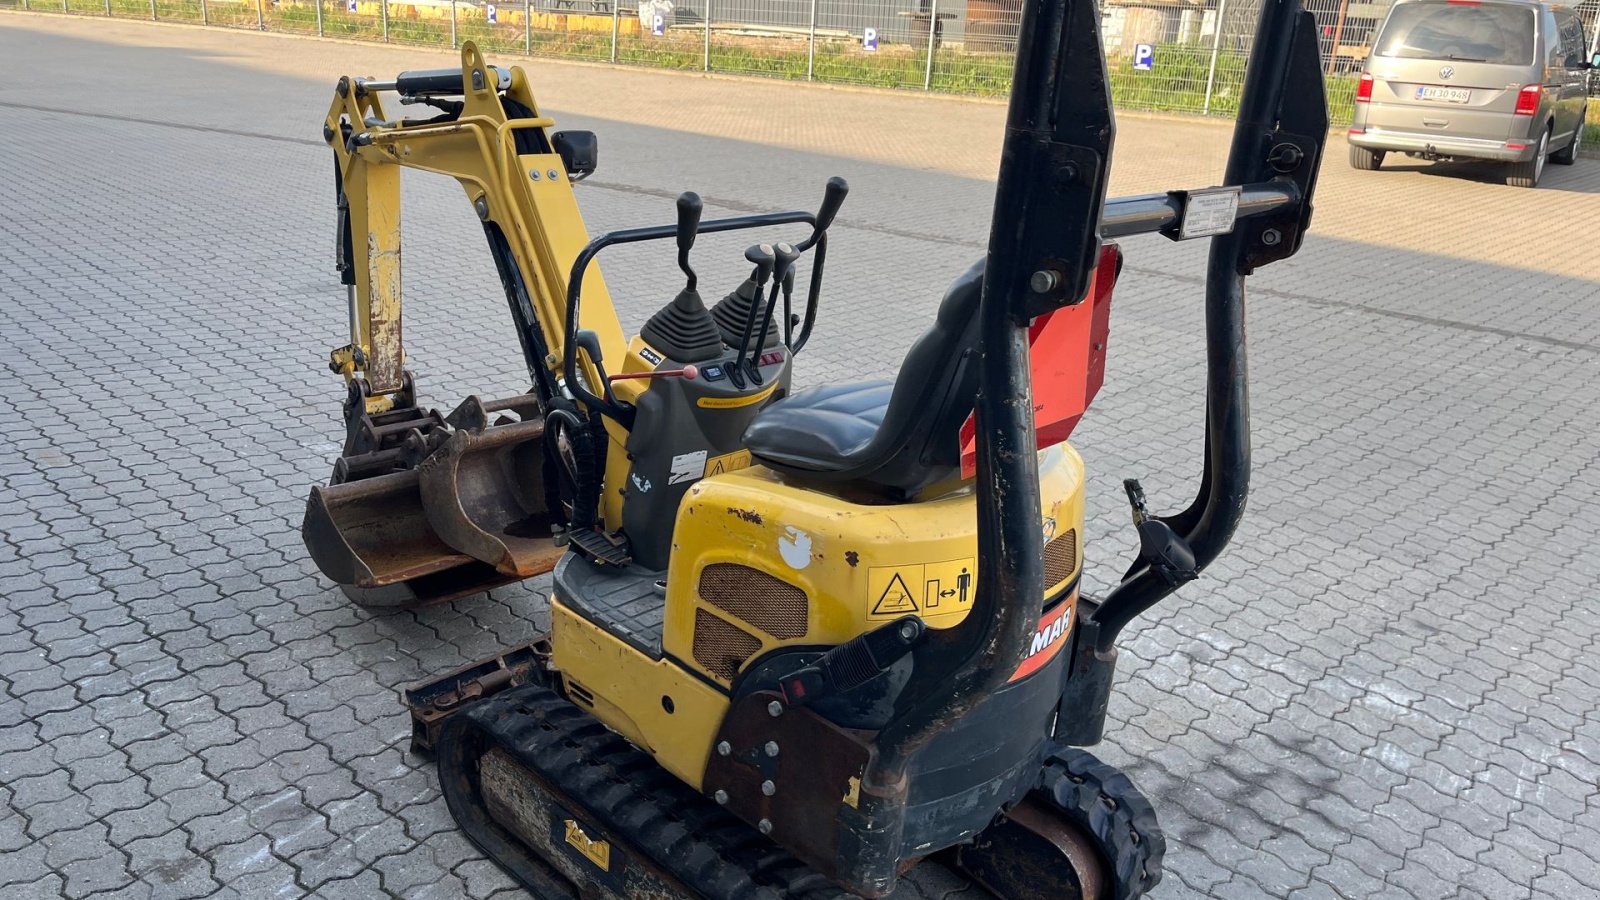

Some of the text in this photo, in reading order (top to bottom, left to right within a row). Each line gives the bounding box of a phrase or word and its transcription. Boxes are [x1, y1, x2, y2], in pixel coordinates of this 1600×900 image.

[487, 4, 496, 19] P
[653, 15, 663, 31] P
[864, 28, 876, 46] P
[1136, 44, 1152, 64] P
[1423, 88, 1468, 100] EH 30 948
[1027, 605, 1072, 659] MAR
